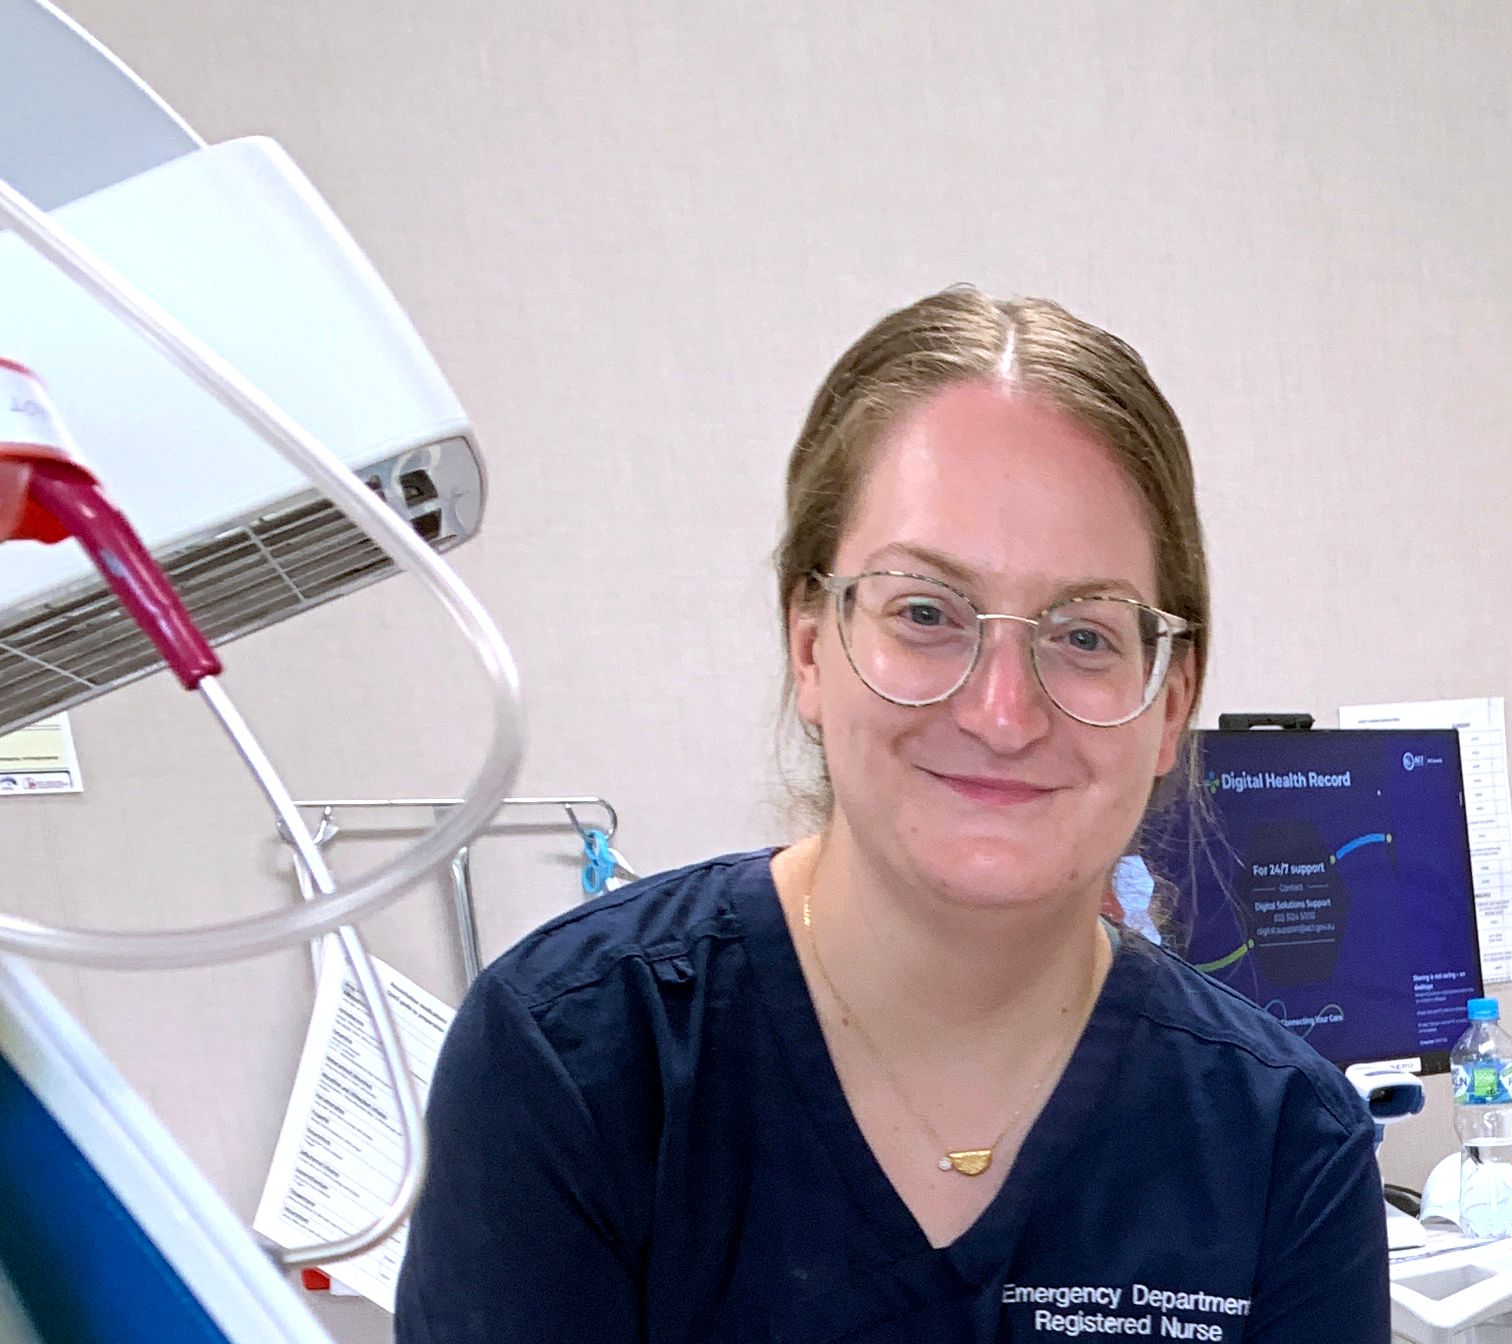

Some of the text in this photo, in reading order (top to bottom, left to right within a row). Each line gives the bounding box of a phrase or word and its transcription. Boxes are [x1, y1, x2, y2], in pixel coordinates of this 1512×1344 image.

[1221, 771, 1351, 792] Digital Health Record
[1253, 861, 1326, 876] For 24/7 support
[1001, 1283, 1251, 1316] Emergency Departmen
[1035, 1310, 1223, 1342] Registered Nurse
